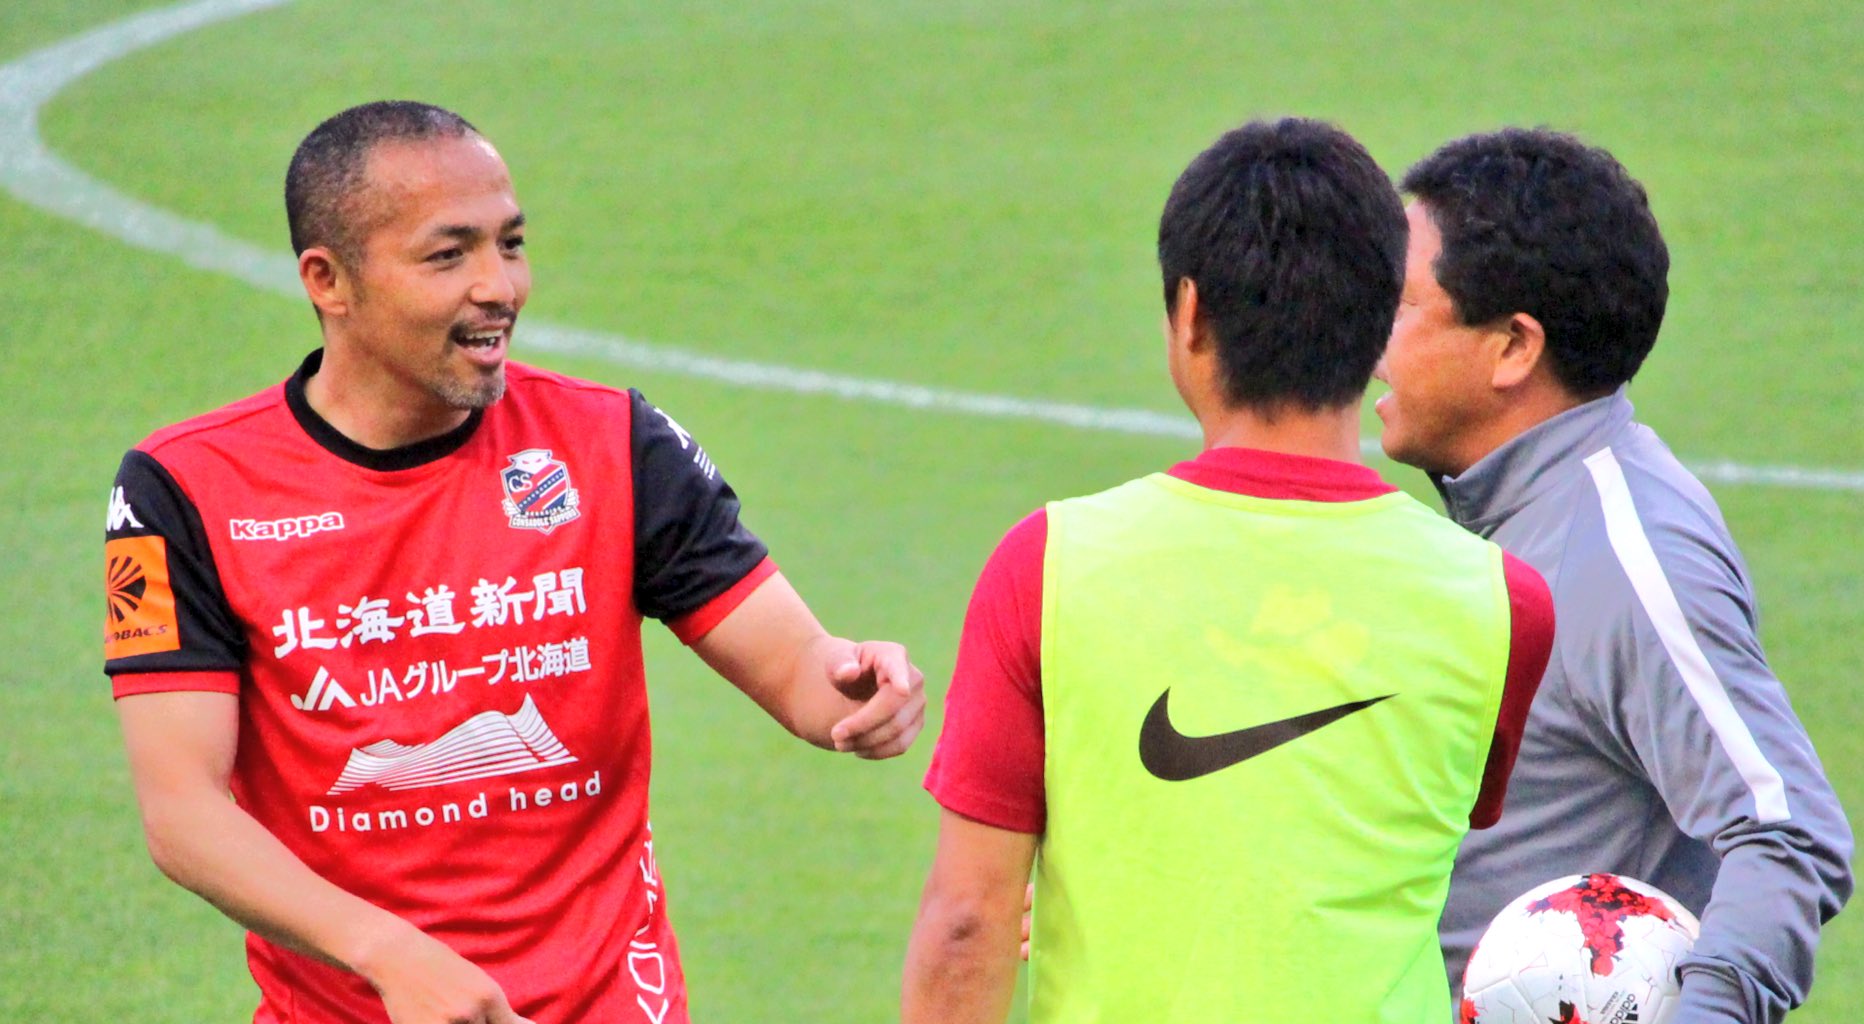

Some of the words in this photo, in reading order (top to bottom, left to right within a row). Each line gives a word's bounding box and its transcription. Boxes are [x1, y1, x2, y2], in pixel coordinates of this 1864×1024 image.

[509, 473, 533, 492] CS
[229, 512, 345, 541] Kappa
[273, 567, 587, 660] 北海道新聞
[309, 794, 489, 832] Diamond
[509, 771, 602, 811] head
